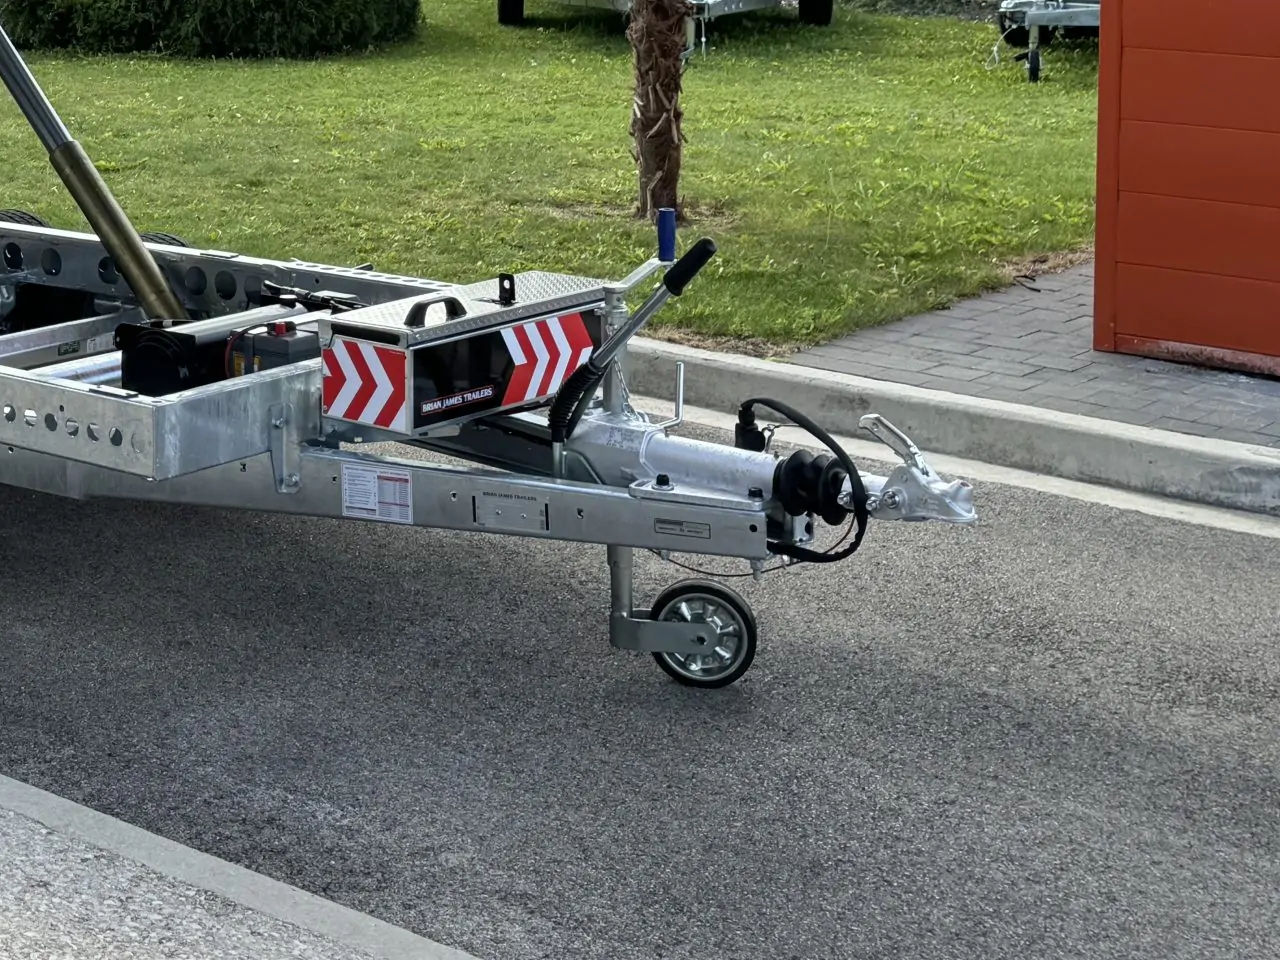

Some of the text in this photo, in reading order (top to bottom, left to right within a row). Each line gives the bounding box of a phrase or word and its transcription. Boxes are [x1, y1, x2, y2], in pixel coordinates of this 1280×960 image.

[422, 387, 493, 412] BRIAN JAMES TRAILERS
